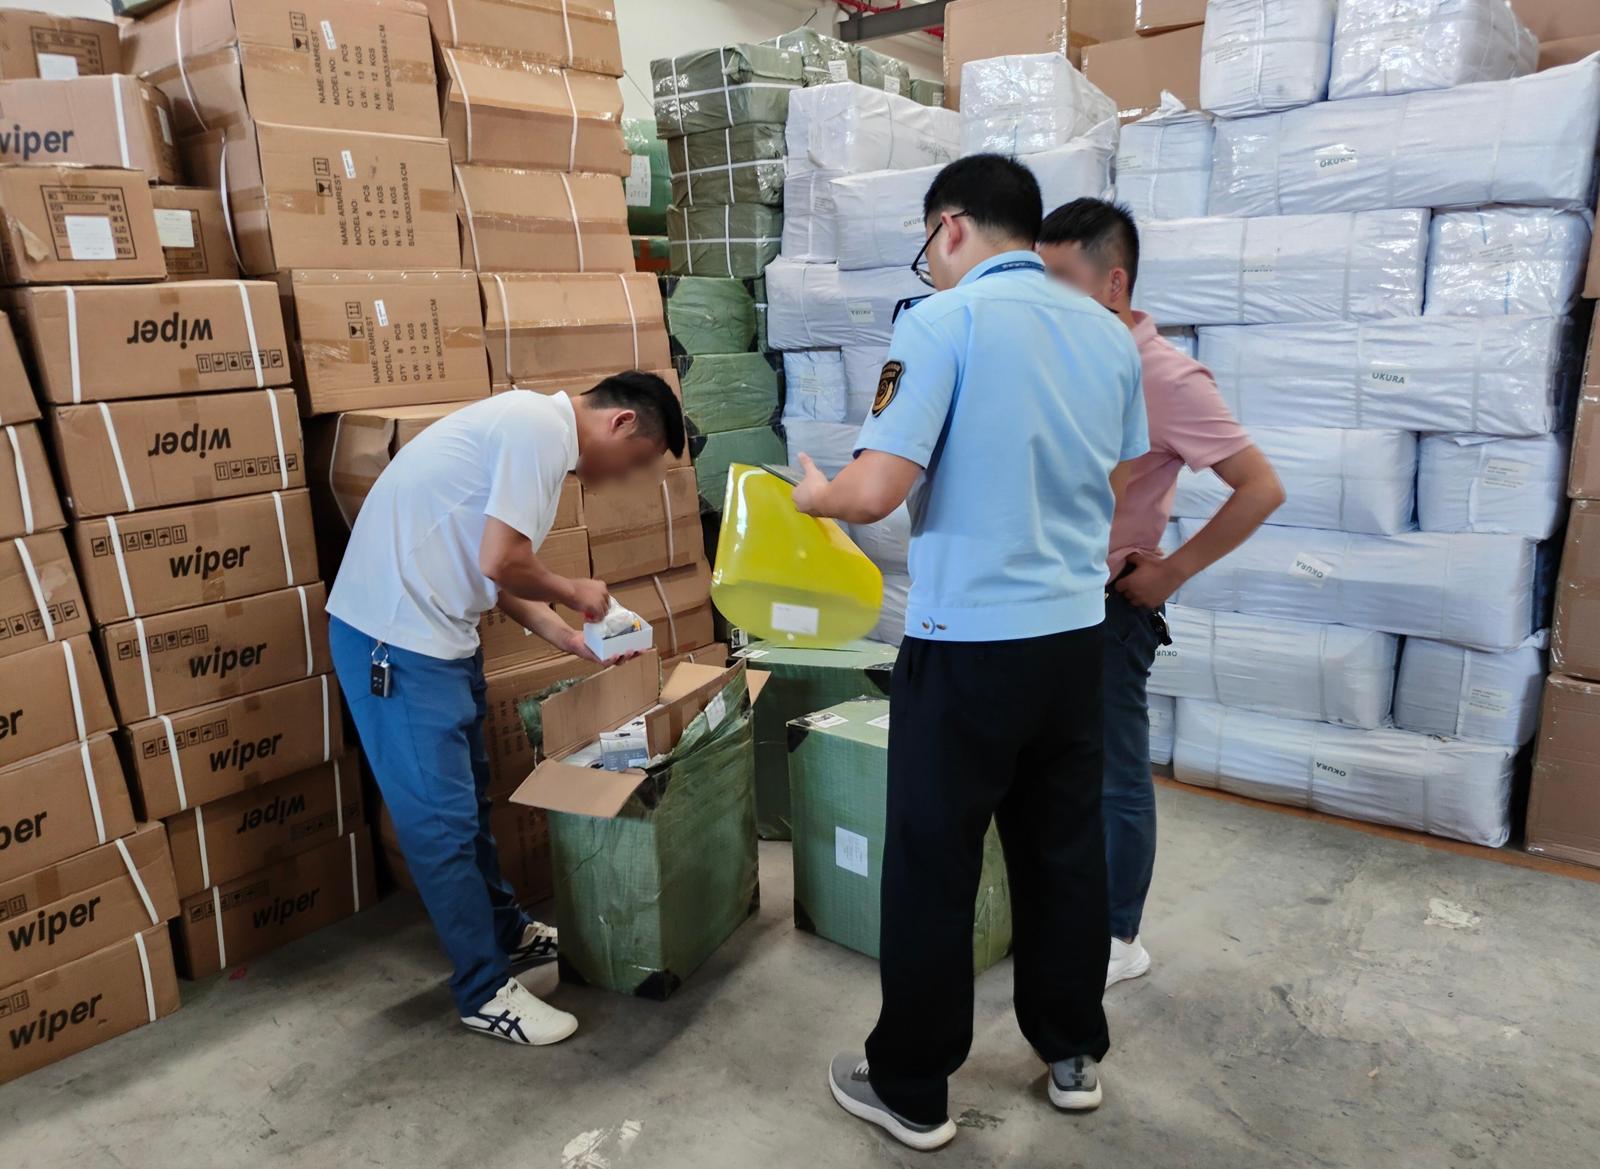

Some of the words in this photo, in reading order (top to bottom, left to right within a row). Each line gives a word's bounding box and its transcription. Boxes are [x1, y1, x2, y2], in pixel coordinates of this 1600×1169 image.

[311, 29, 322, 75] ARMREST
[340, 44, 348, 62] PCS
[354, 46, 363, 64] KGS
[368, 48, 376, 66] KGS
[332, 75, 340, 106] MODEL
[372, 72, 378, 82] 12
[334, 174, 345, 216] ARMREST
[362, 184, 371, 203] PCS
[376, 185, 384, 204] KGS
[390, 186, 398, 204] KGS
[392, 210, 399, 219] 12
[353, 215, 362, 246] MODEL
[127, 312, 212, 349] wiper
[366, 316, 377, 356] ARMREST
[394, 323, 402, 340] PCS
[407, 322, 415, 340] KGS
[420, 322, 428, 340] KGS
[385, 354, 394, 382] MODEL
[148, 423, 231, 458] wiper
[170, 546, 250, 580] wiper
[1296, 560, 1323, 578] OKURA
[189, 641, 266, 678] wiper
[210, 732, 282, 772] wiper
[1316, 762, 1346, 777] OKURA
[236, 794, 305, 834] wiper
[252, 887, 320, 929] wiper
[9, 897, 100, 951] wiper
[10, 994, 102, 1049] wiper
